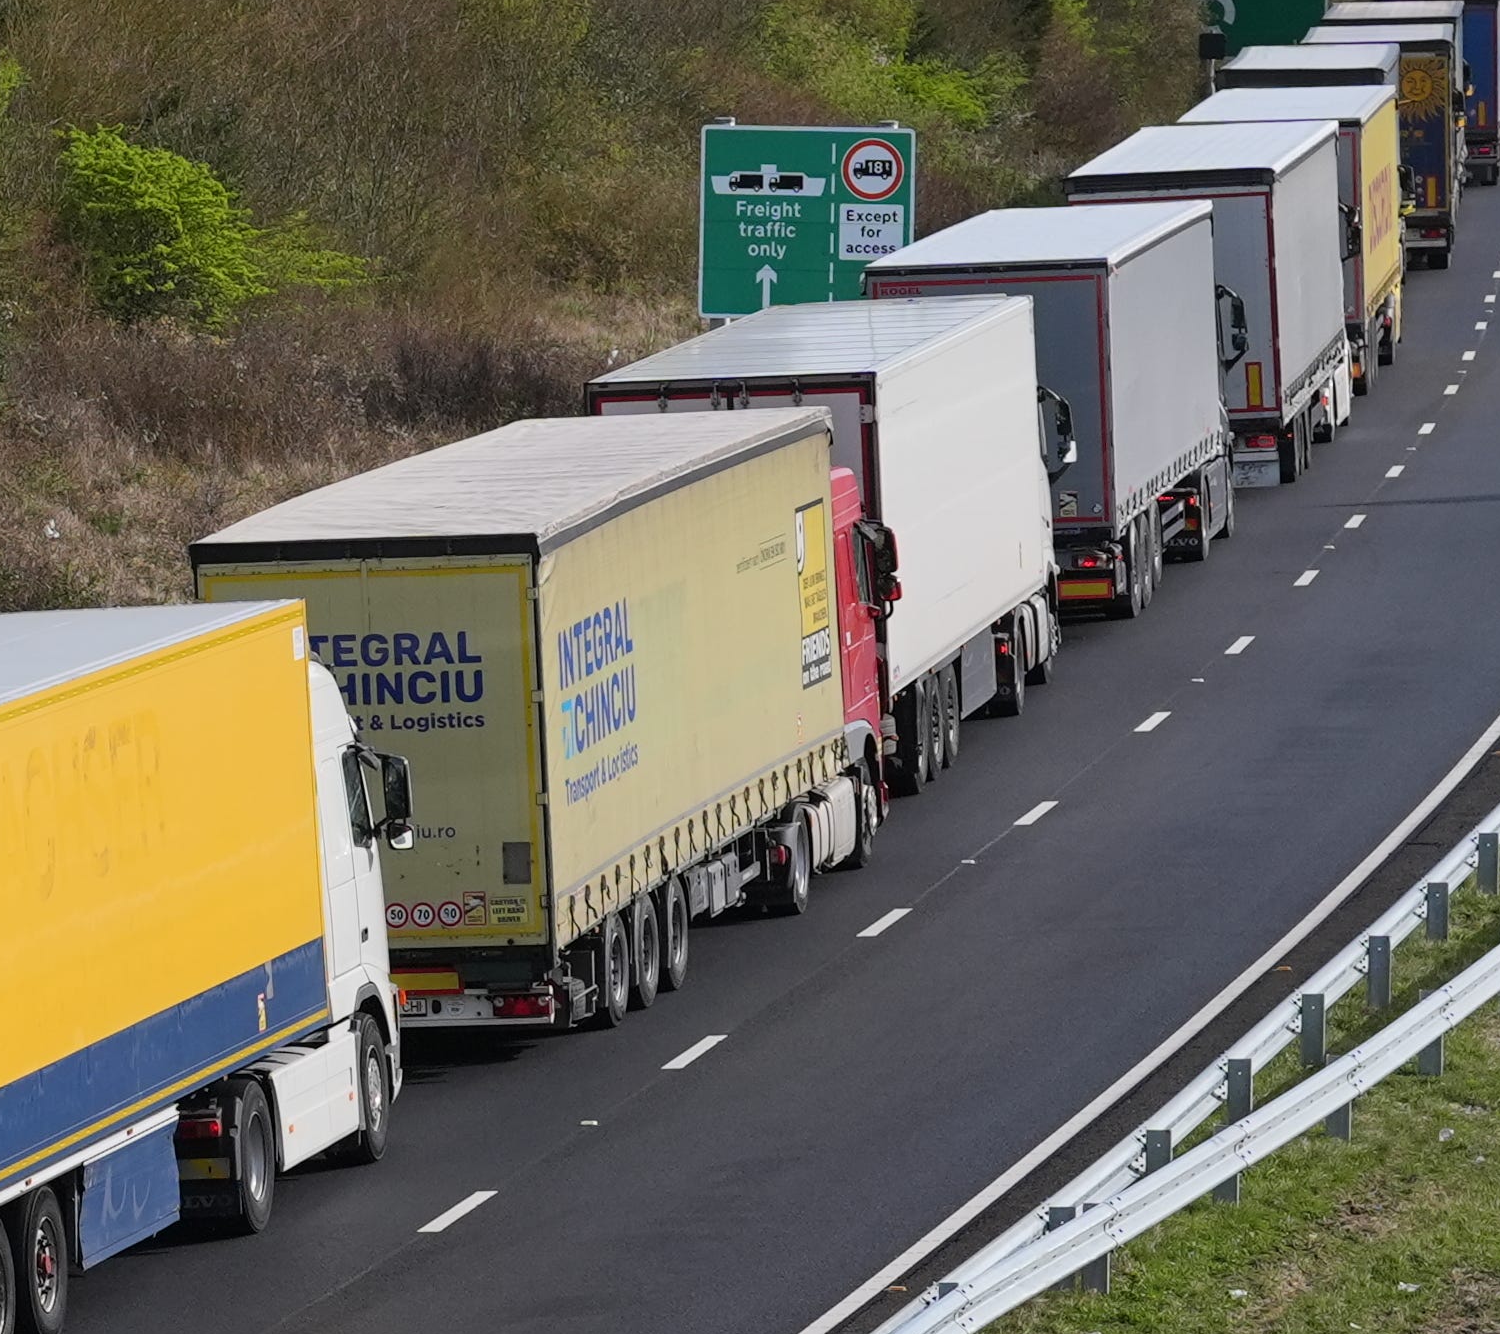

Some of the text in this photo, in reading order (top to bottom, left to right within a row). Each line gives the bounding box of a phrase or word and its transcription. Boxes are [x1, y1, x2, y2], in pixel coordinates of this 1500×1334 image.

[736, 200, 801, 219] Freight
[846, 209, 898, 224] Except
[739, 222, 796, 238] traffic
[861, 225, 882, 238] for
[748, 241, 787, 259] only
[846, 244, 896, 254] access
[309, 631, 482, 667] TEGRAL
[558, 597, 634, 691] INTEGRAL
[338, 670, 484, 705] HINCIU
[574, 663, 636, 754] CHINCIU
[369, 715, 383, 730] &
[390, 713, 485, 732] Logistics
[564, 761, 600, 806] Transport
[390, 908, 404, 921] 50
[417, 908, 430, 921] 70
